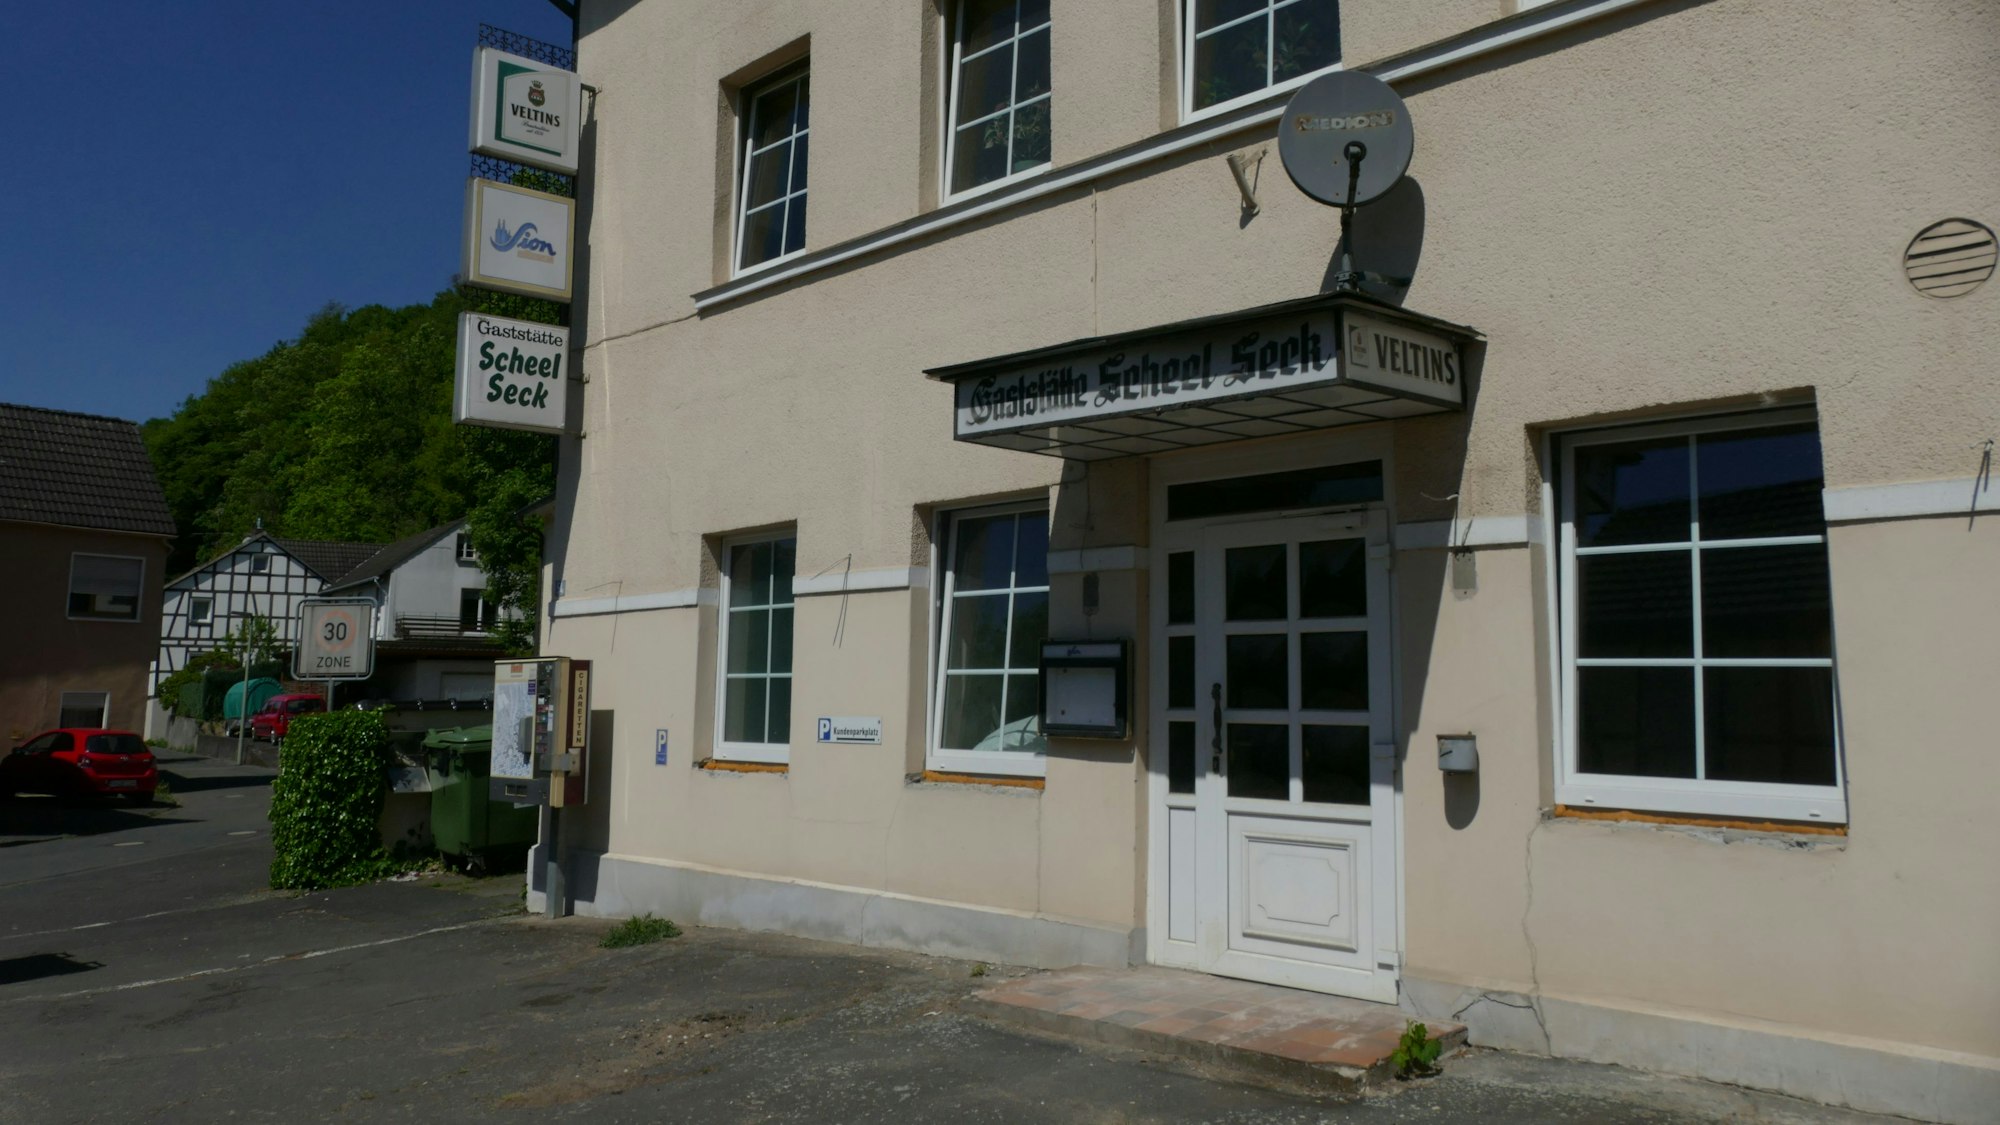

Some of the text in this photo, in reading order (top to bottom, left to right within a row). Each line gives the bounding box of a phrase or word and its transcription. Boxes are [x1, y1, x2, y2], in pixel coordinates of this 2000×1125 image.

[511, 103, 560, 127] VELTINS
[477, 319, 563, 347] Gaststätte
[479, 340, 562, 379] Scheel
[966, 321, 1332, 426] Gaststätte Scheel Seck
[1374, 333, 1456, 385] VELTINS
[486, 372, 549, 409] Seck
[324, 622, 347, 641] 30
[316, 656, 351, 668] ZONE
[576, 672, 584, 744] CIGARETTEN
[833, 727, 878, 737] Kundenparkplatz
